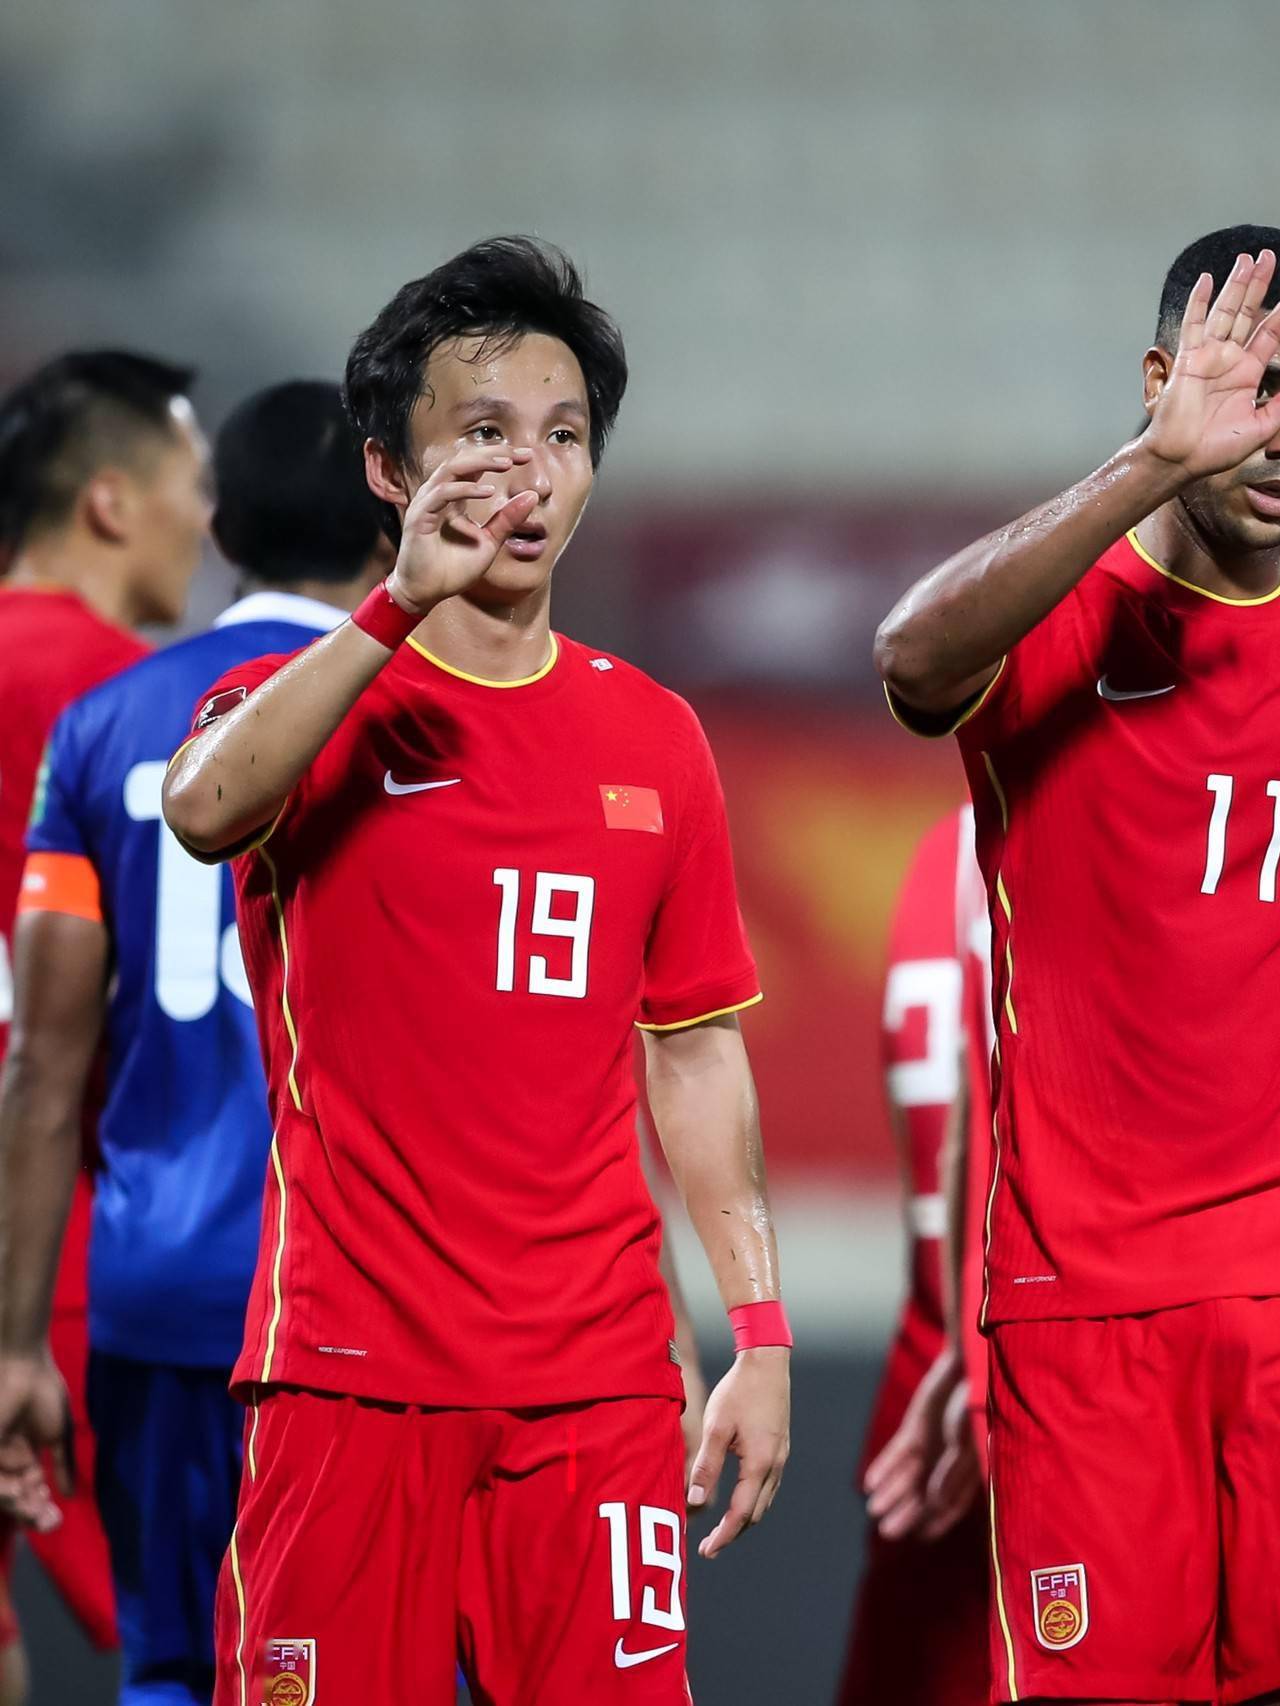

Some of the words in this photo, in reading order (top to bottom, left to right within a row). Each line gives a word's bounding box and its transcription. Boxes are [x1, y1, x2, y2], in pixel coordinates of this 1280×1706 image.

[123, 760, 256, 1022] 1
[493, 867, 595, 999] 19
[598, 1502, 686, 1631] 19
[1037, 1572, 1078, 1591] CFA
